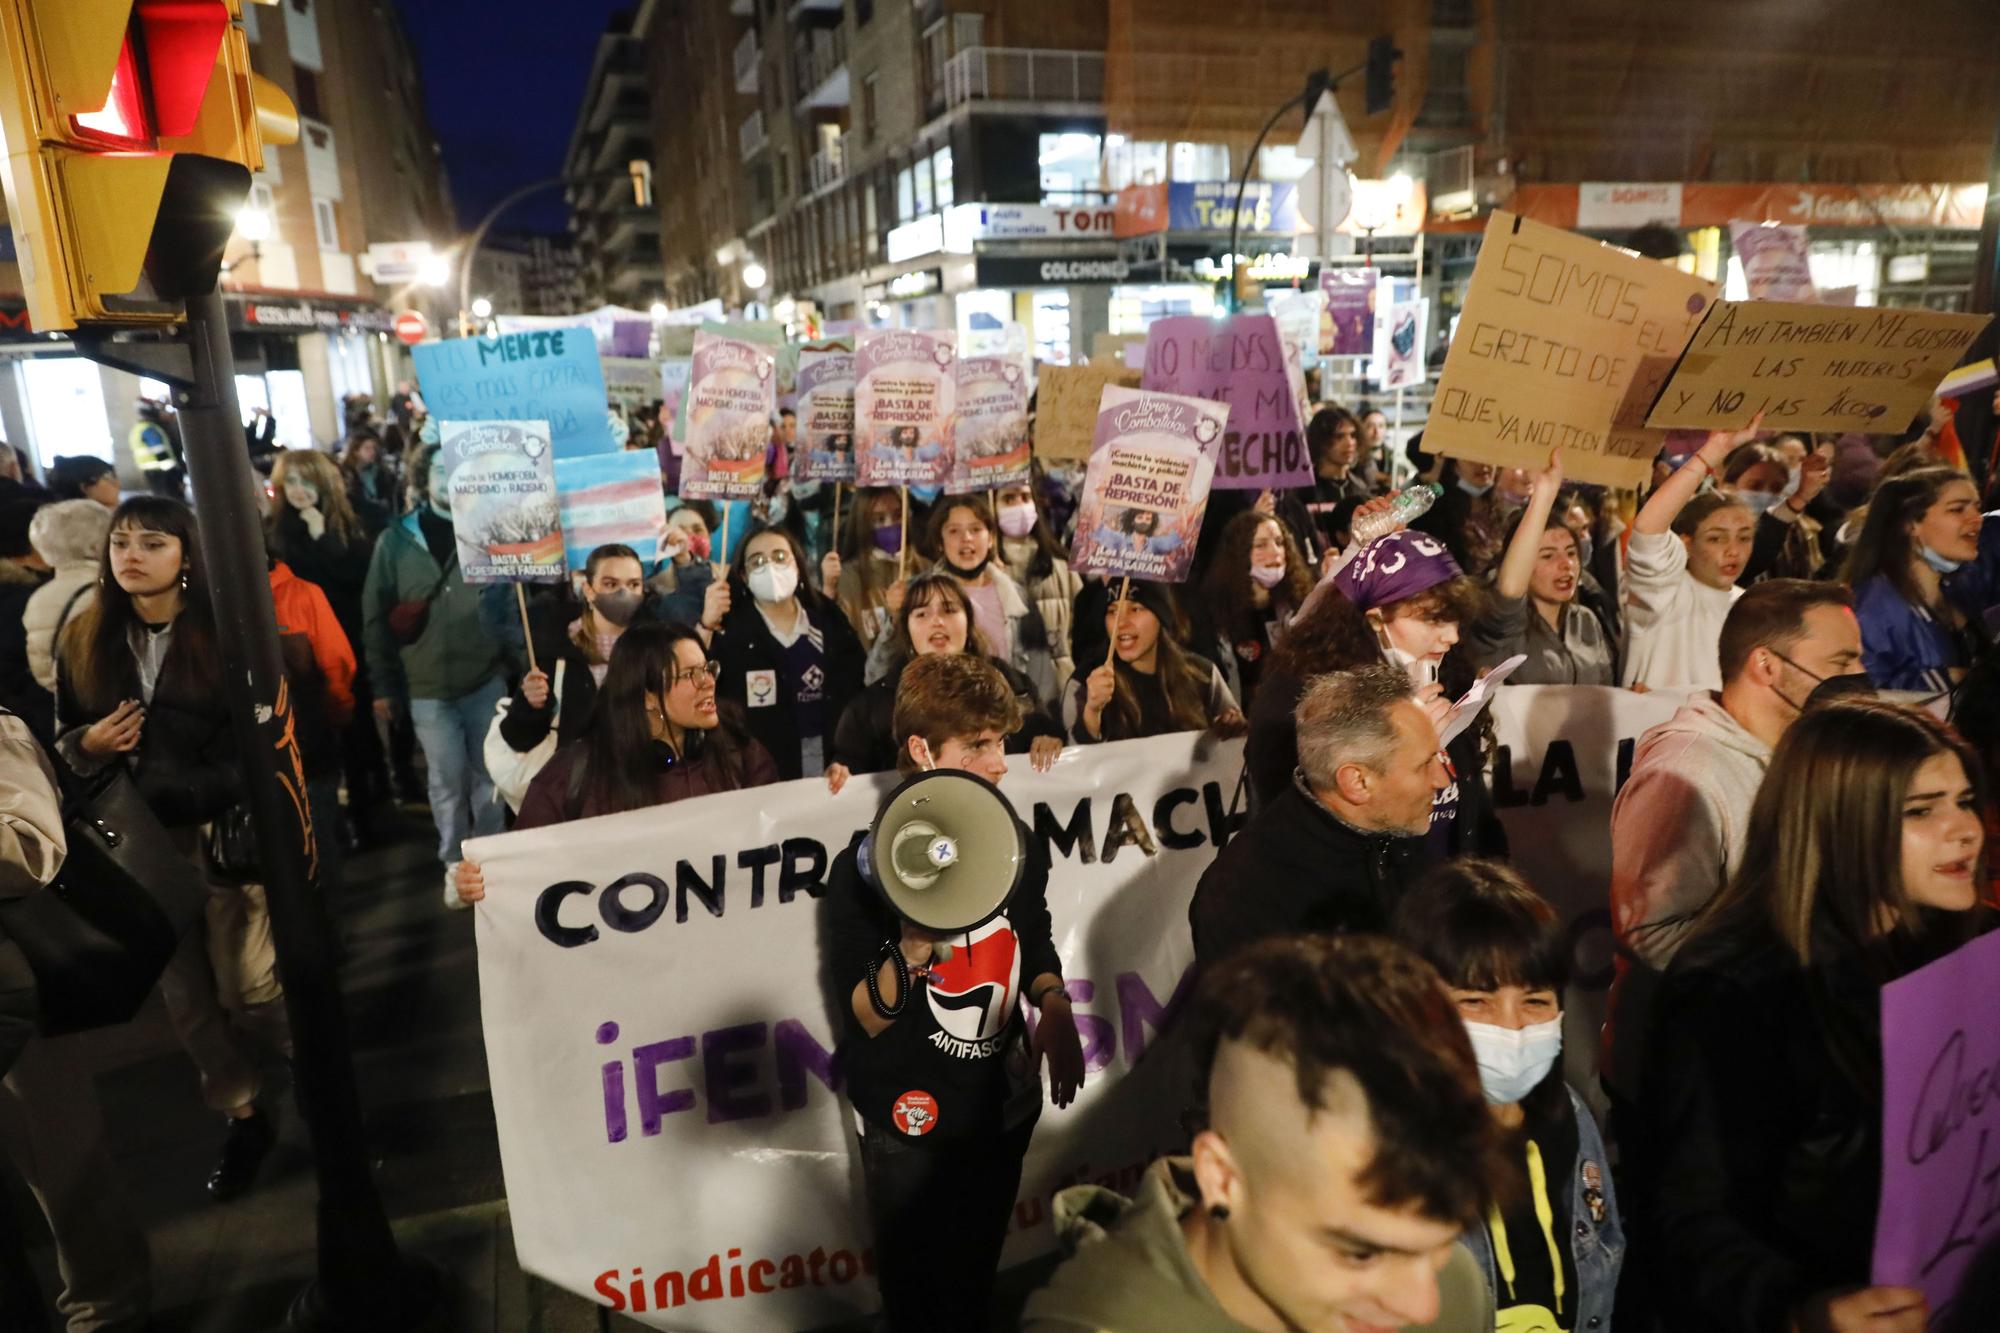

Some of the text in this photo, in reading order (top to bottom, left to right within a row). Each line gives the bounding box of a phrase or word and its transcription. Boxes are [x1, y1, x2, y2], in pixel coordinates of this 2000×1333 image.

[1496, 243, 1647, 326] SOMOS
[1637, 319, 1667, 353] EL
[1858, 313, 1912, 347] ME
[1903, 329, 1976, 350] GUSTAN
[477, 330, 566, 368] MENTE
[1468, 322, 1626, 388] GRITO DE
[1751, 356, 1805, 379] LAS
[874, 398, 932, 411] ¡BASTA DE
[1673, 391, 1696, 415] Y
[1706, 387, 1746, 417] NO
[1758, 396, 1807, 418] LAS
[873, 410, 933, 421] REPRESIÓN!
[1114, 409, 1187, 434] Combativas
[1441, 388, 1497, 422] QUE
[1524, 420, 1556, 446] NO
[1111, 449, 1189, 468] ¡Contra la violencia
[1214, 429, 1310, 478] ECHO.
[870, 470, 885, 479] NO
[1111, 460, 1147, 471] machista
[508, 482, 548, 494] RACISMO
[1108, 473, 1182, 495] ¡BASTA DE
[1104, 487, 1179, 509] REPRESIÓN!
[466, 564, 563, 577] AGRESIONES FASCISTAS
[491, 554, 533, 565] BASTA DE
[1087, 555, 1167, 576] NO PASARÁN!
[535, 837, 828, 948] CONTR
